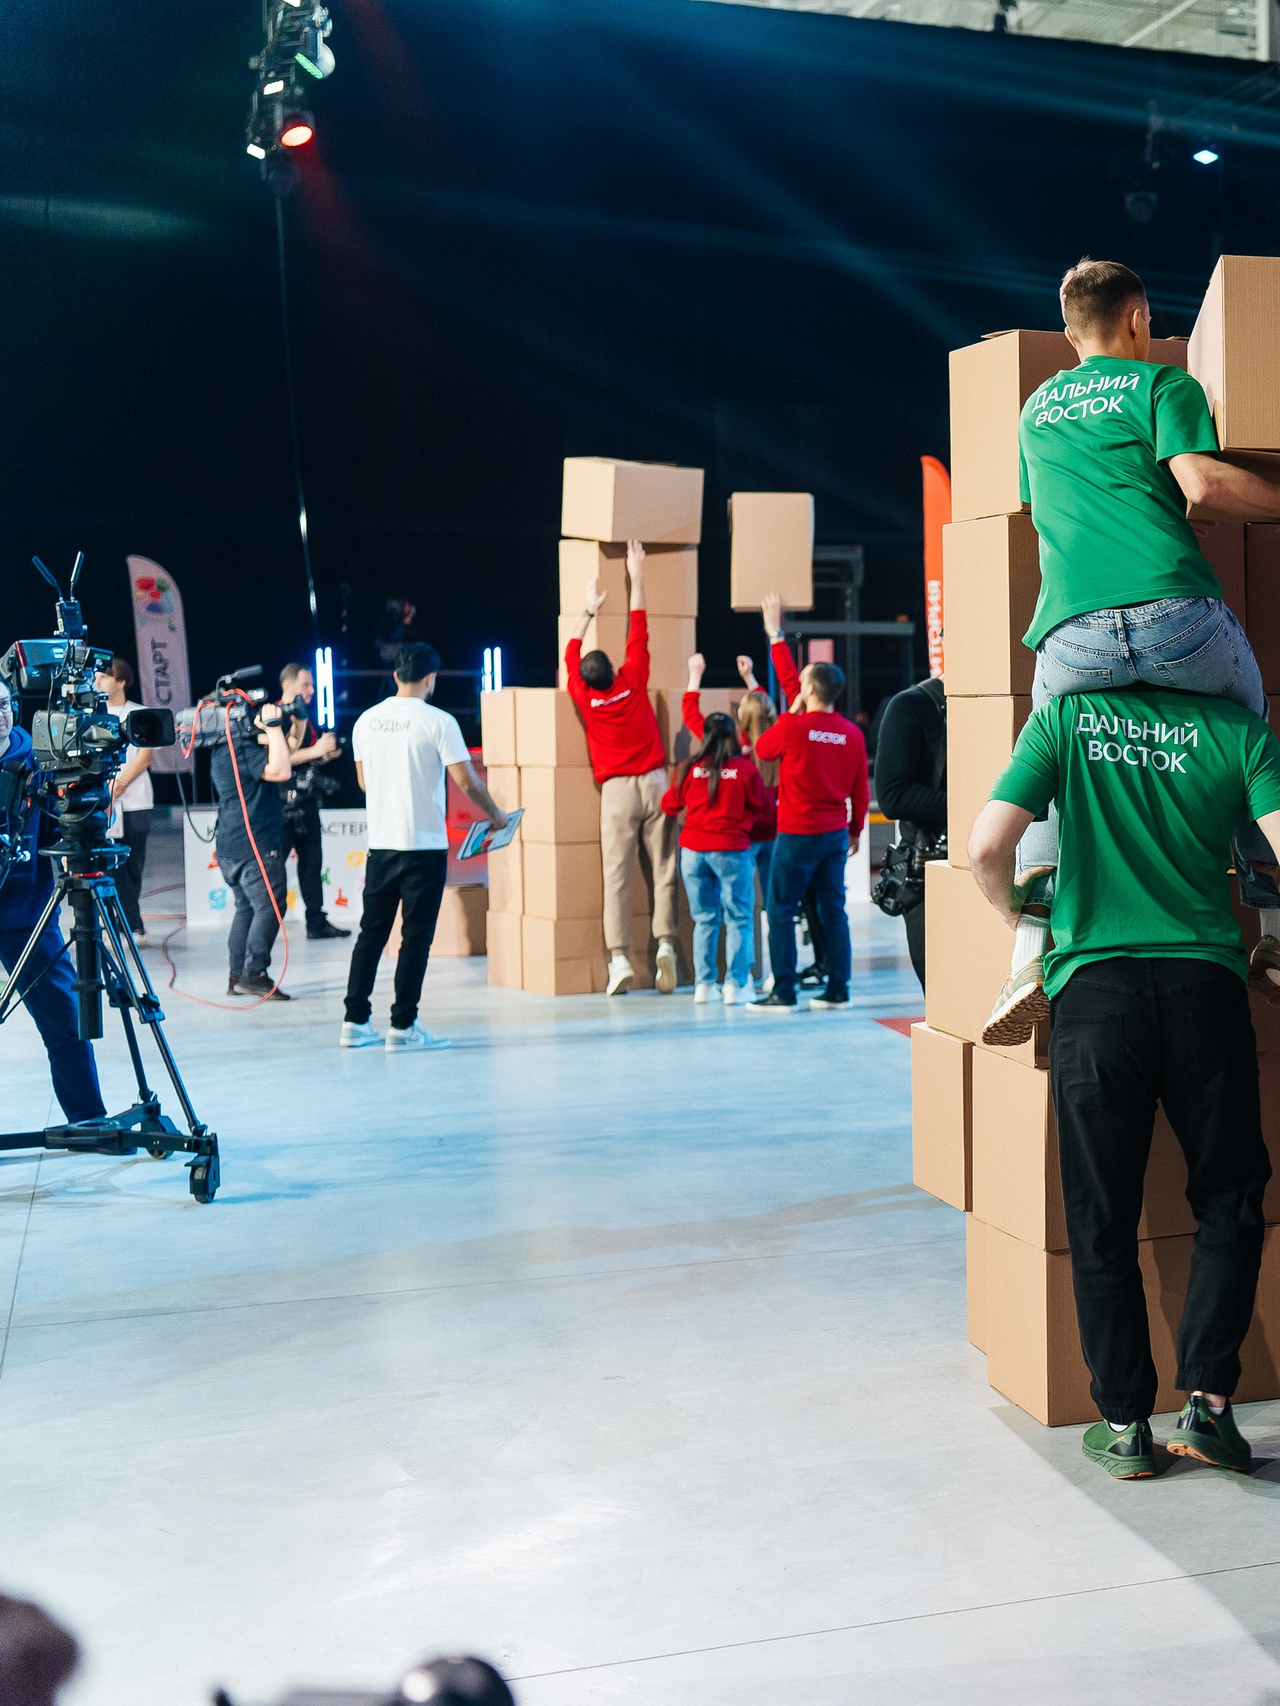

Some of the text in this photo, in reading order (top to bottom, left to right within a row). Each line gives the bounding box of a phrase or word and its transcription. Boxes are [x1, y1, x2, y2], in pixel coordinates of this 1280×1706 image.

[1031, 372, 1141, 414] ДАЛЬНИЙ
[1035, 394, 1125, 428] ВОСТОК
[927, 579, 944, 679] ИТОРИЯ
[150, 637, 173, 705] СТАРТ
[369, 717, 411, 733] СУДЬЯ
[808, 729, 847, 746] ВОСТОК
[1076, 712, 1199, 748] ДАЛЬНИЙ
[692, 766, 739, 780] ВООК
[1088, 739, 1189, 774] ВОСТОК
